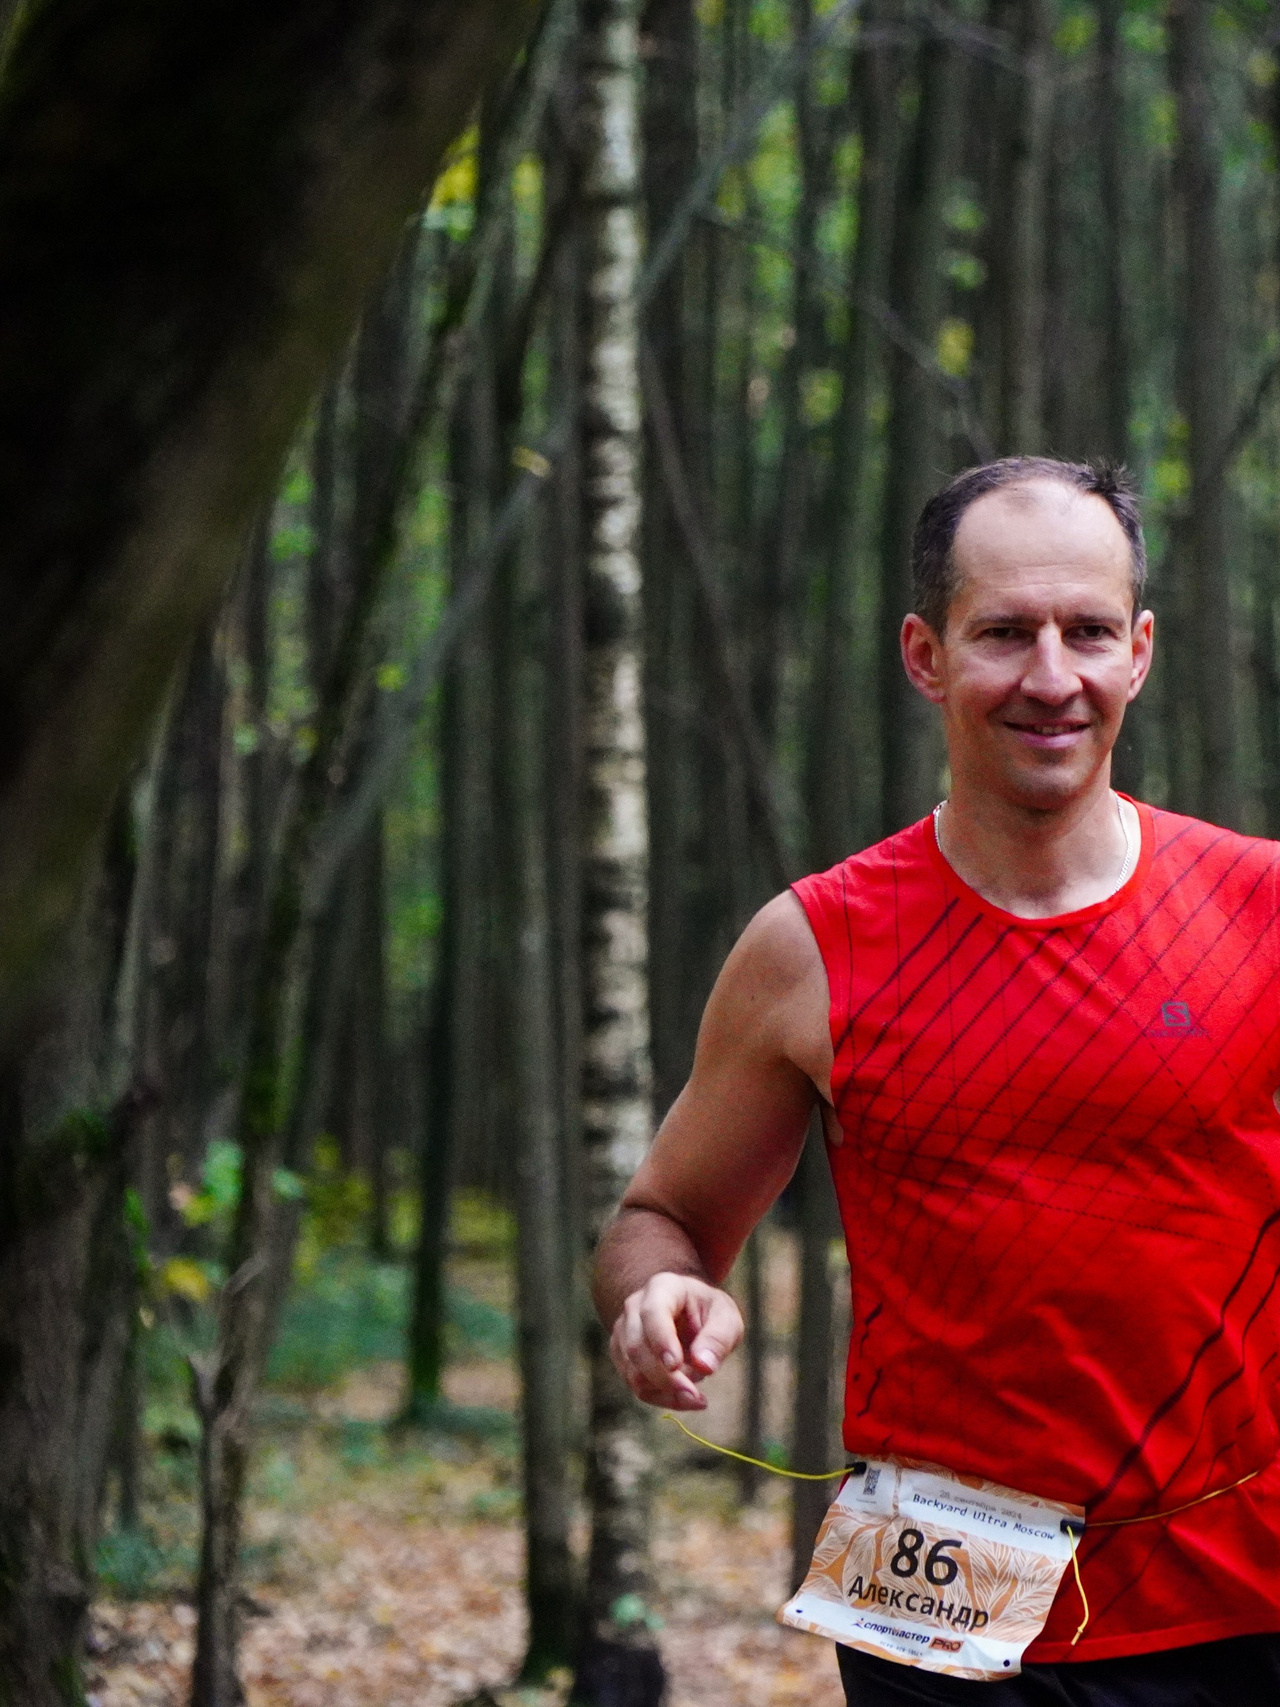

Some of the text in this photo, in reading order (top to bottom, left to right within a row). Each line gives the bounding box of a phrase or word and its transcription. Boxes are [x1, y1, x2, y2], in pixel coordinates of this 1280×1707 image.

[912, 1494, 1054, 1540] Backyard Ultra Moscow
[890, 1529, 962, 1586] 86
[848, 1576, 989, 1632] Александр
[931, 1637, 962, 1652] PRO
